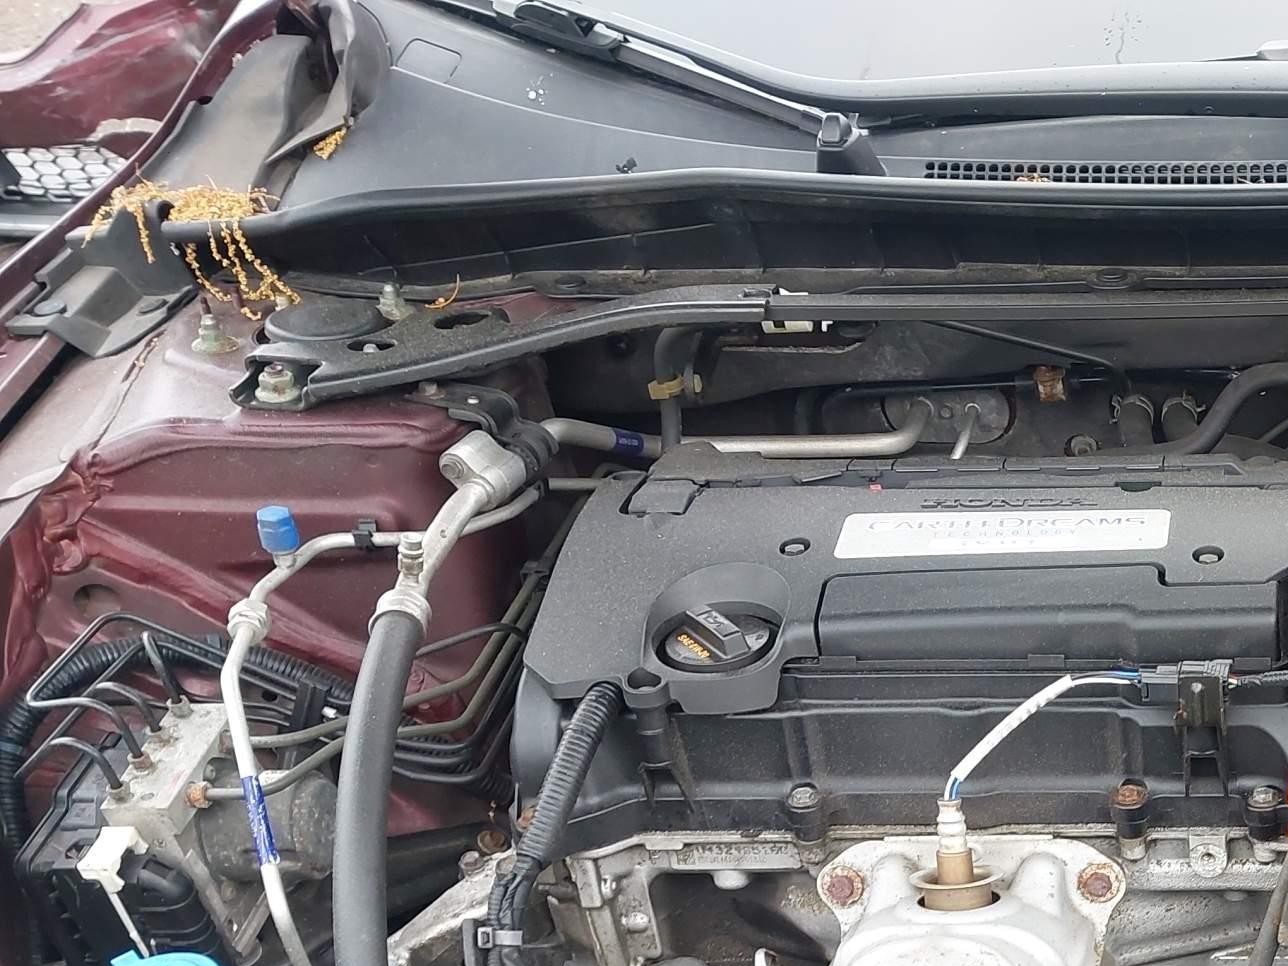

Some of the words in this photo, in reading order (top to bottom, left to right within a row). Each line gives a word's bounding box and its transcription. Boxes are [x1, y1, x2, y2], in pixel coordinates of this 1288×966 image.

[920, 498, 1098, 509] HONDA
[868, 516, 990, 530] EARTH
[998, 515, 1147, 528] DREAMS
